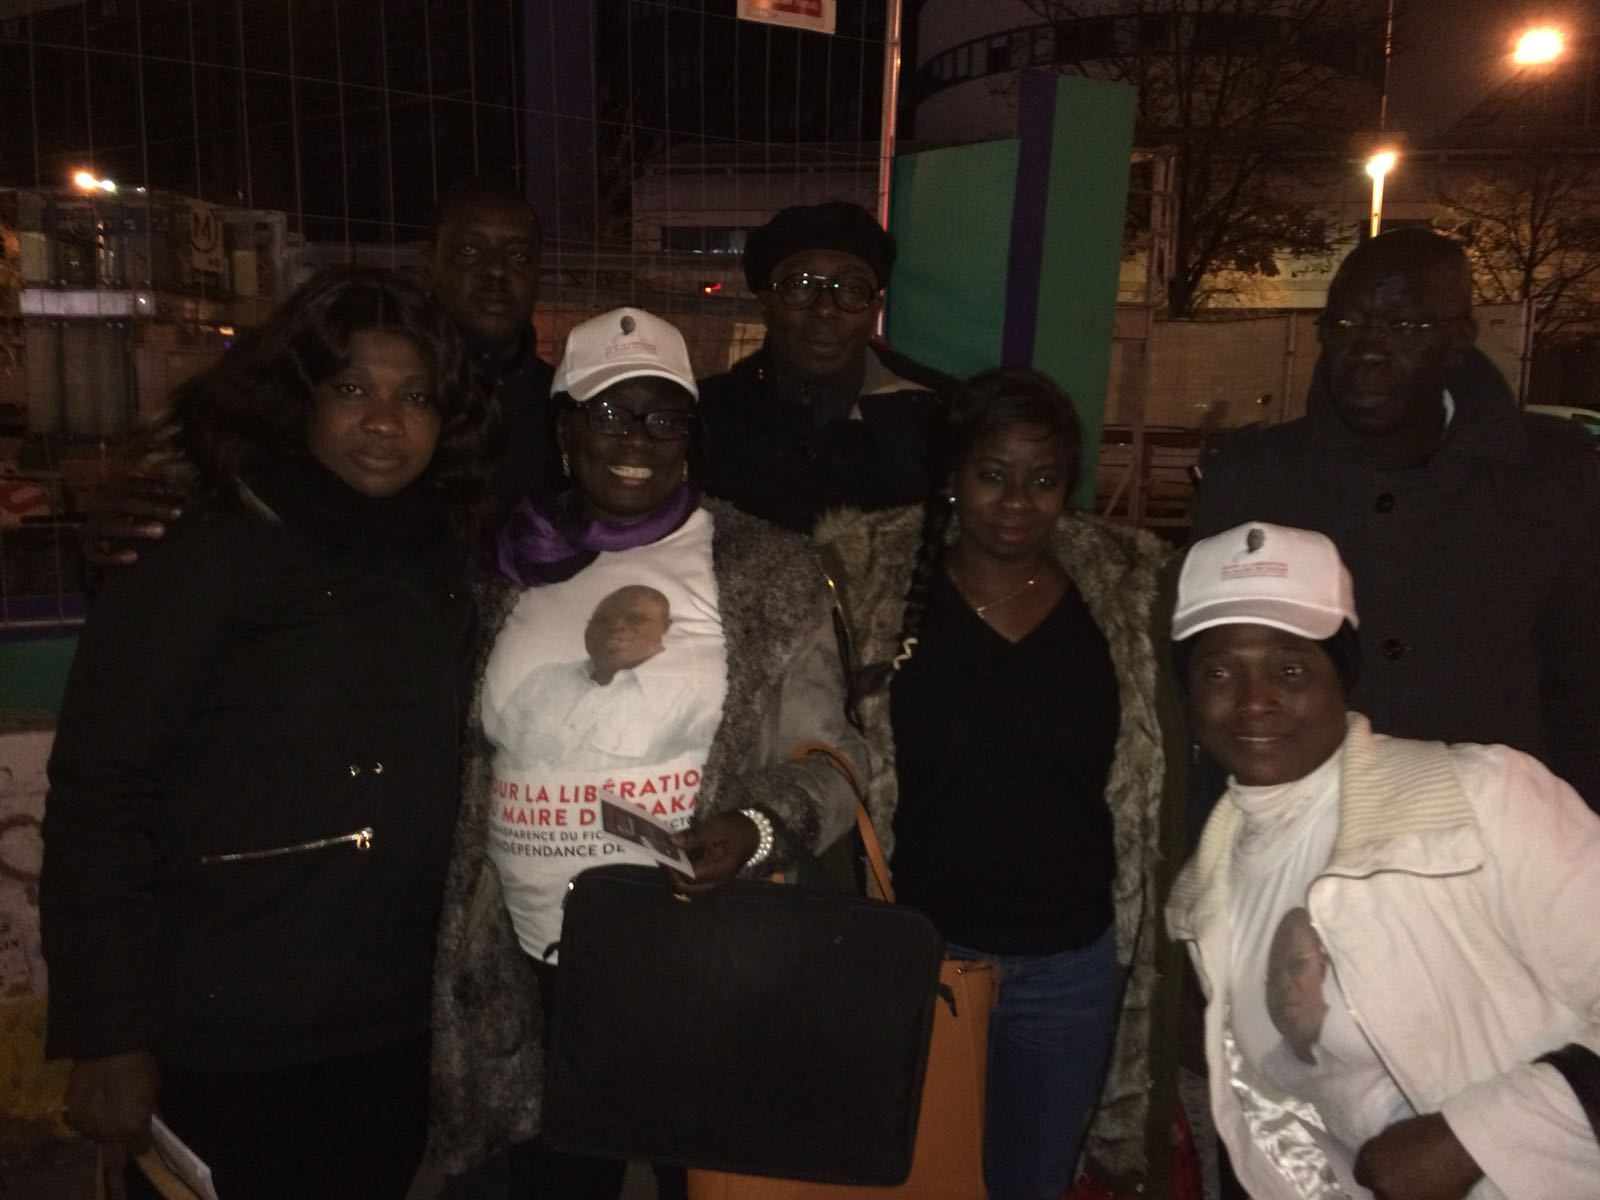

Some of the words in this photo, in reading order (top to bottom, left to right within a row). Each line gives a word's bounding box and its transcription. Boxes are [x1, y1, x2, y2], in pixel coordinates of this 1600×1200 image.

[491, 777, 518, 801] OUR
[525, 783, 550, 803] LA
[559, 769, 700, 804] LIBÉRATIO
[502, 804, 567, 827] MAIRE
[579, 808, 597, 827] D
[560, 831, 578, 841] DU
[582, 830, 604, 841] FIC
